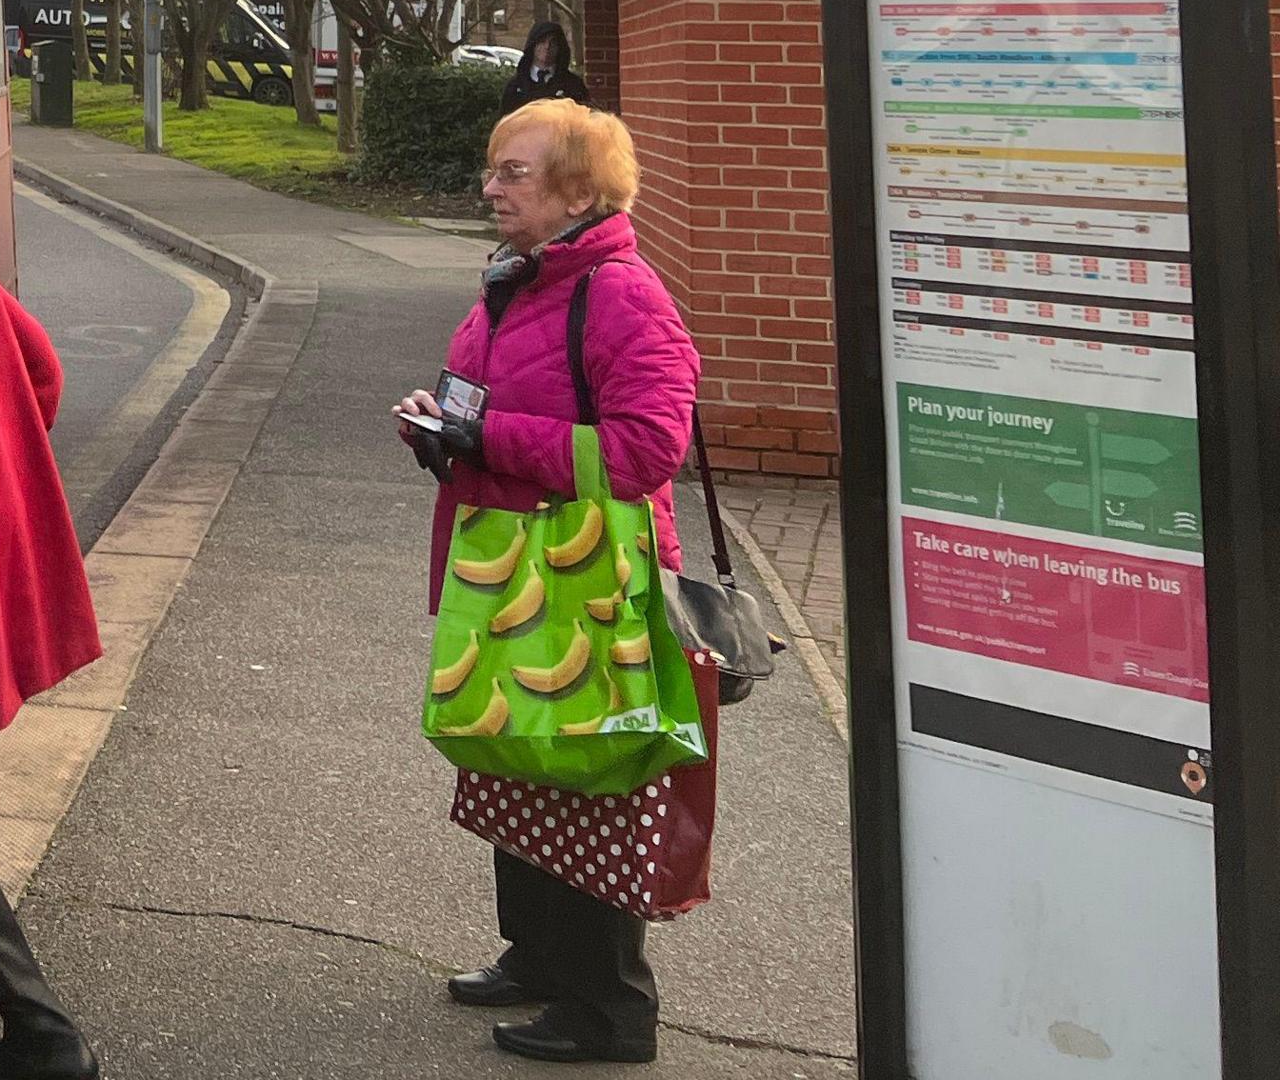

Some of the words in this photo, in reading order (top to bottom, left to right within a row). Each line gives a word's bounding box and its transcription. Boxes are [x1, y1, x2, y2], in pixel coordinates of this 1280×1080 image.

[907, 395, 943, 417] Plan
[945, 404, 984, 422] your
[987, 405, 1054, 435] journey
[912, 531, 950, 554] Take
[952, 540, 989, 560] care
[993, 547, 1040, 569] when
[1043, 553, 1109, 580] leaving
[1111, 567, 1142, 588] the
[1148, 571, 1182, 596] bus
